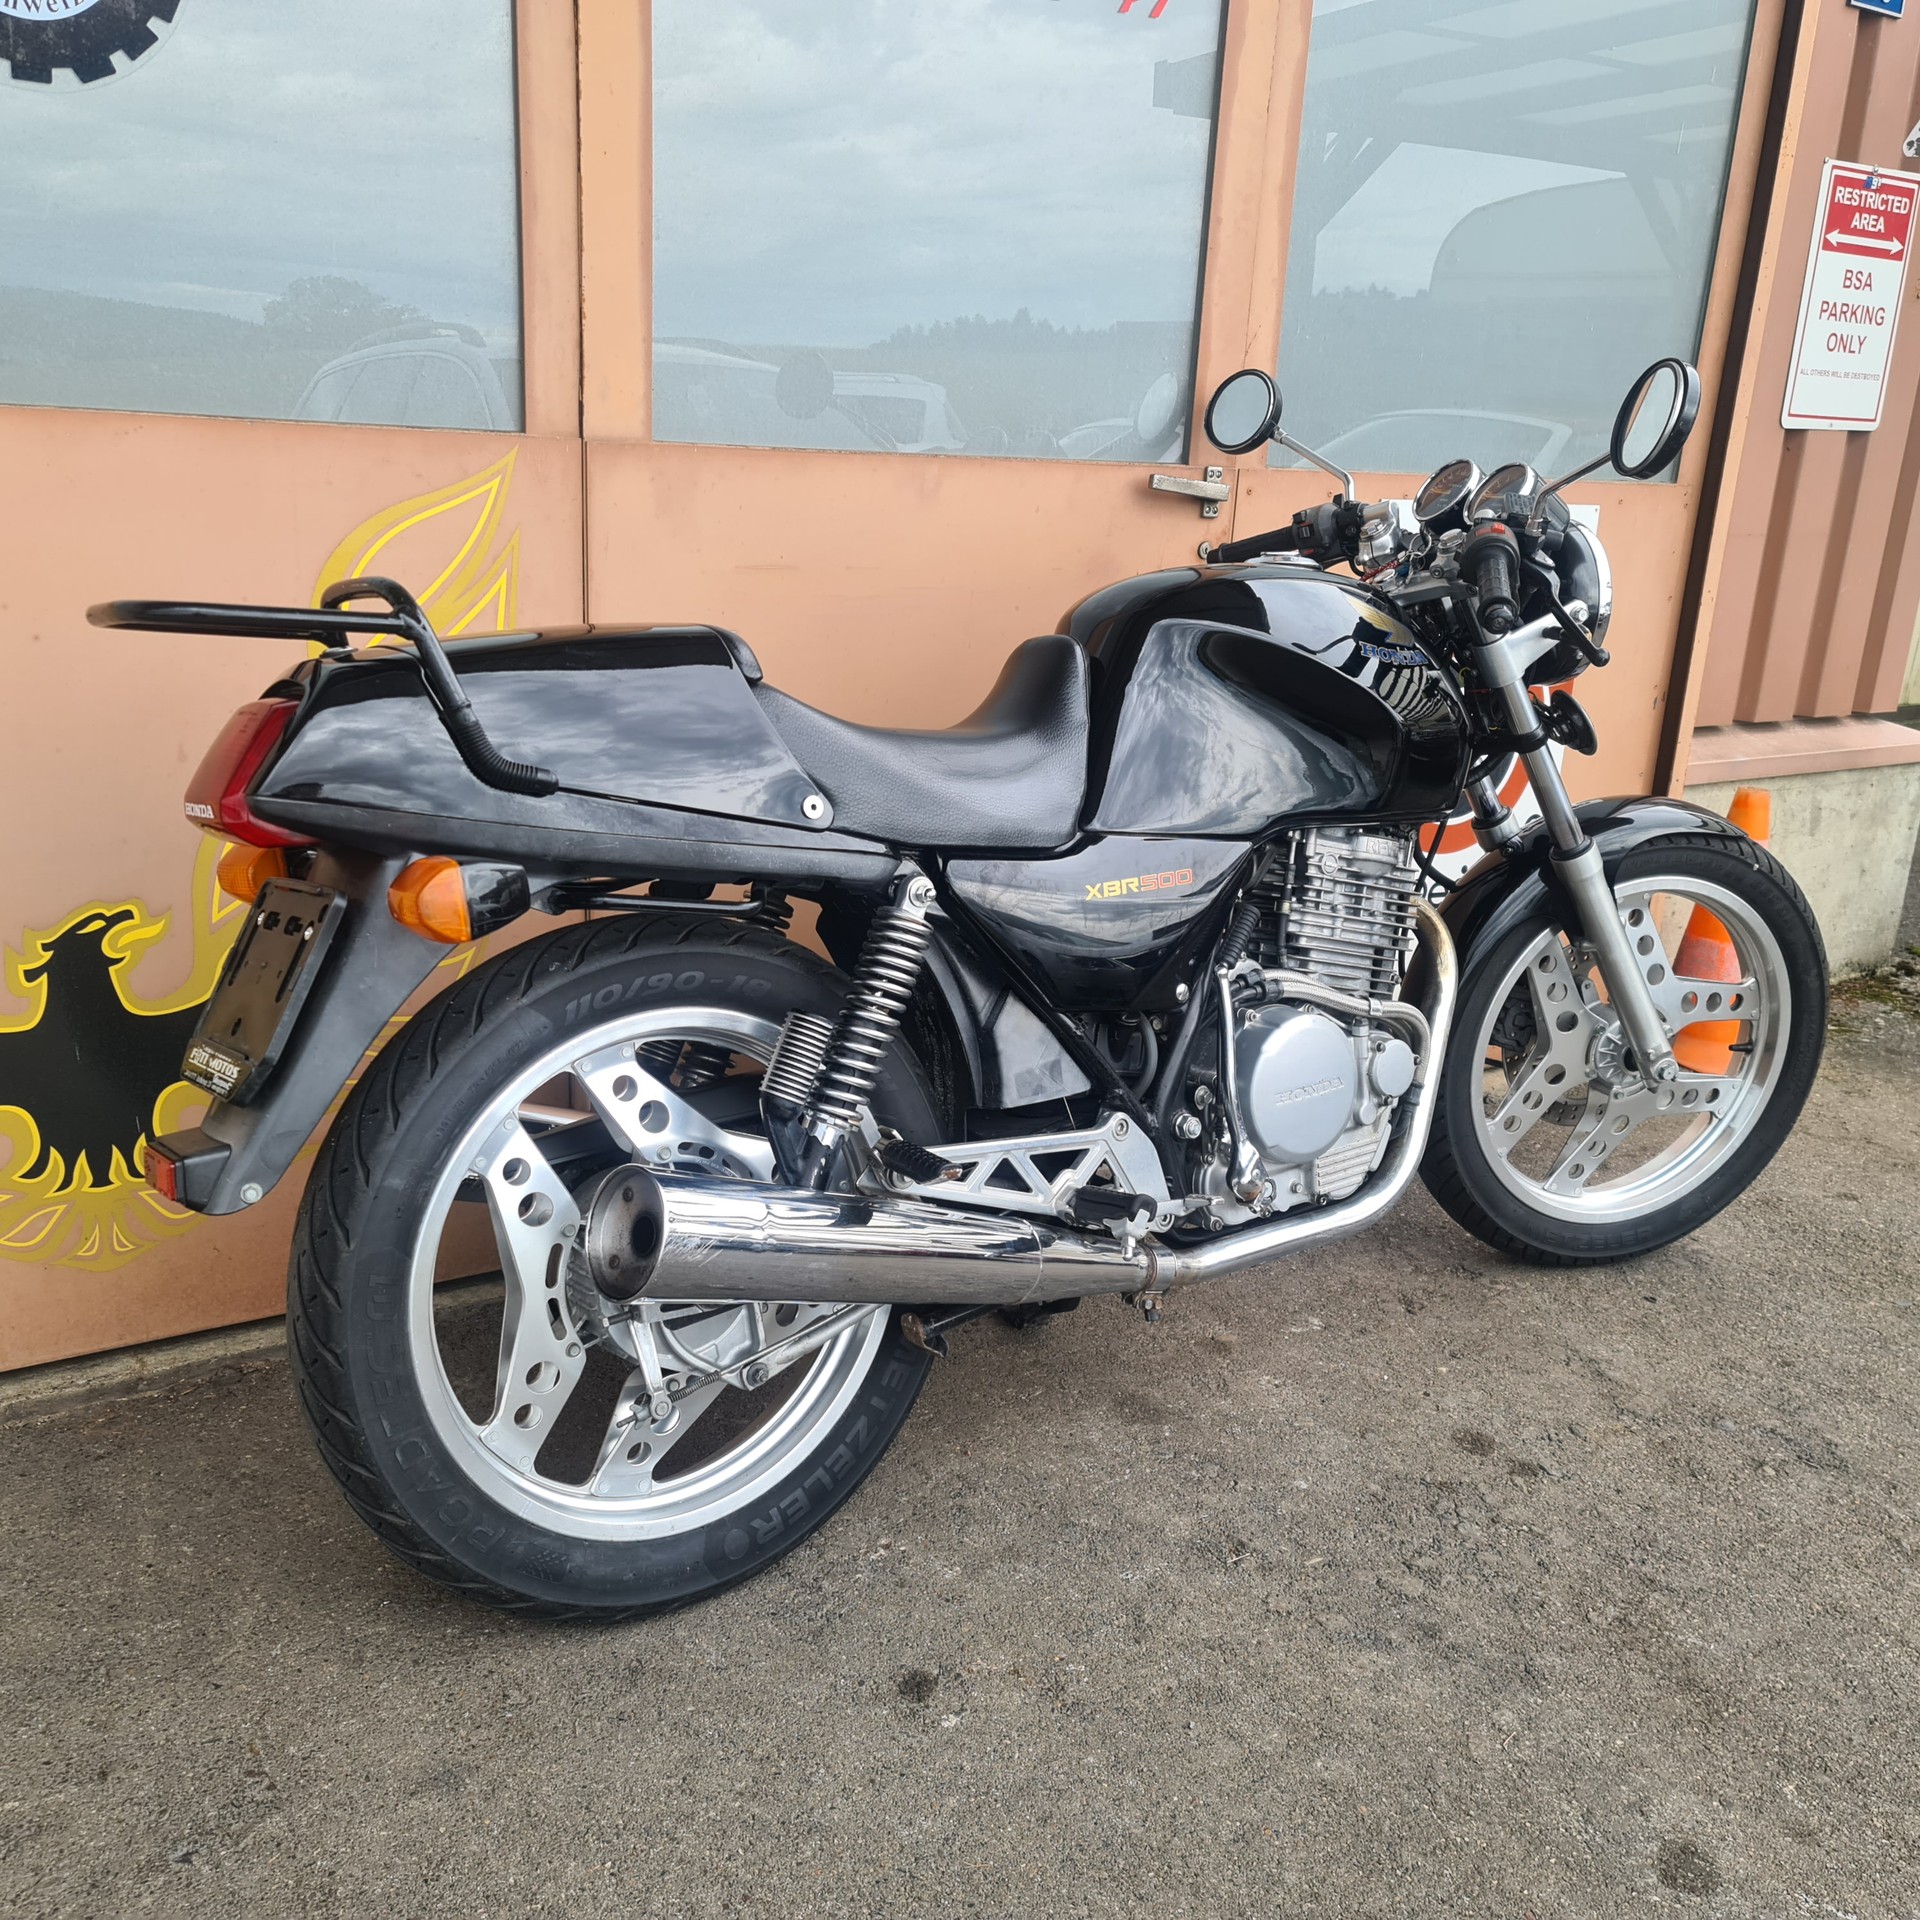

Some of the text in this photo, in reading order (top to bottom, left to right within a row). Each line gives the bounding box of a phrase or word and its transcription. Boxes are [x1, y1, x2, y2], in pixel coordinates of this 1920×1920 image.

[1835, 186, 1910, 215] RESTRICTED
[1850, 212, 1885, 233] AREA
[1842, 269, 1873, 292] BSA
[1818, 300, 1886, 327] PARKING
[1826, 332, 1867, 355] ONLY
[1810, 369, 1830, 377] OTHERS
[1359, 641, 1428, 666] HONDA
[185, 802, 215, 819] HONDA
[1085, 868, 1193, 901] XBR500
[1274, 1077, 1345, 1106] HONDA
